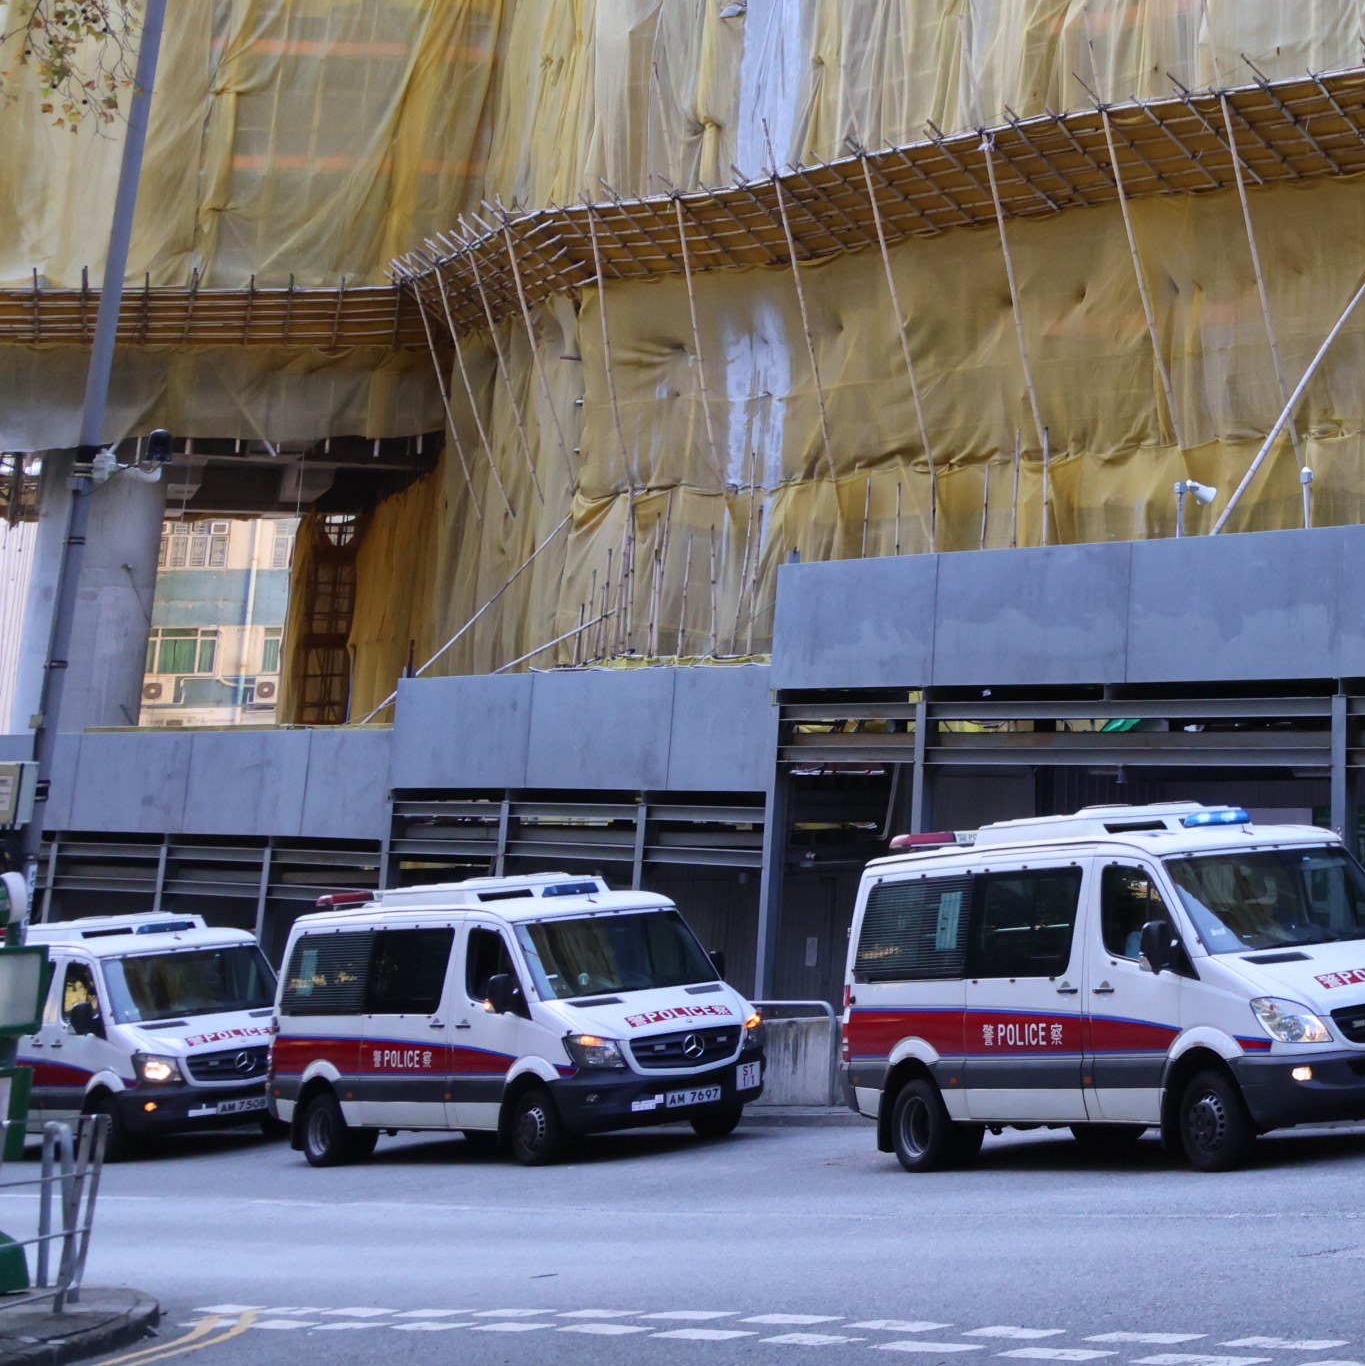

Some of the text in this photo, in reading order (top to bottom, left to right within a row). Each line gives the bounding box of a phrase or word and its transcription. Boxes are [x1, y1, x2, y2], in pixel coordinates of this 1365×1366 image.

[647, 1006, 714, 1023] POLICE
[982, 1022, 1063, 1046] 警 POLICE 察
[384, 1050, 420, 1068] POLICE
[742, 1064, 755, 1076] ST
[669, 1094, 685, 1105] AM
[690, 1089, 719, 1103] 7697
[221, 1103, 236, 1113] AM
